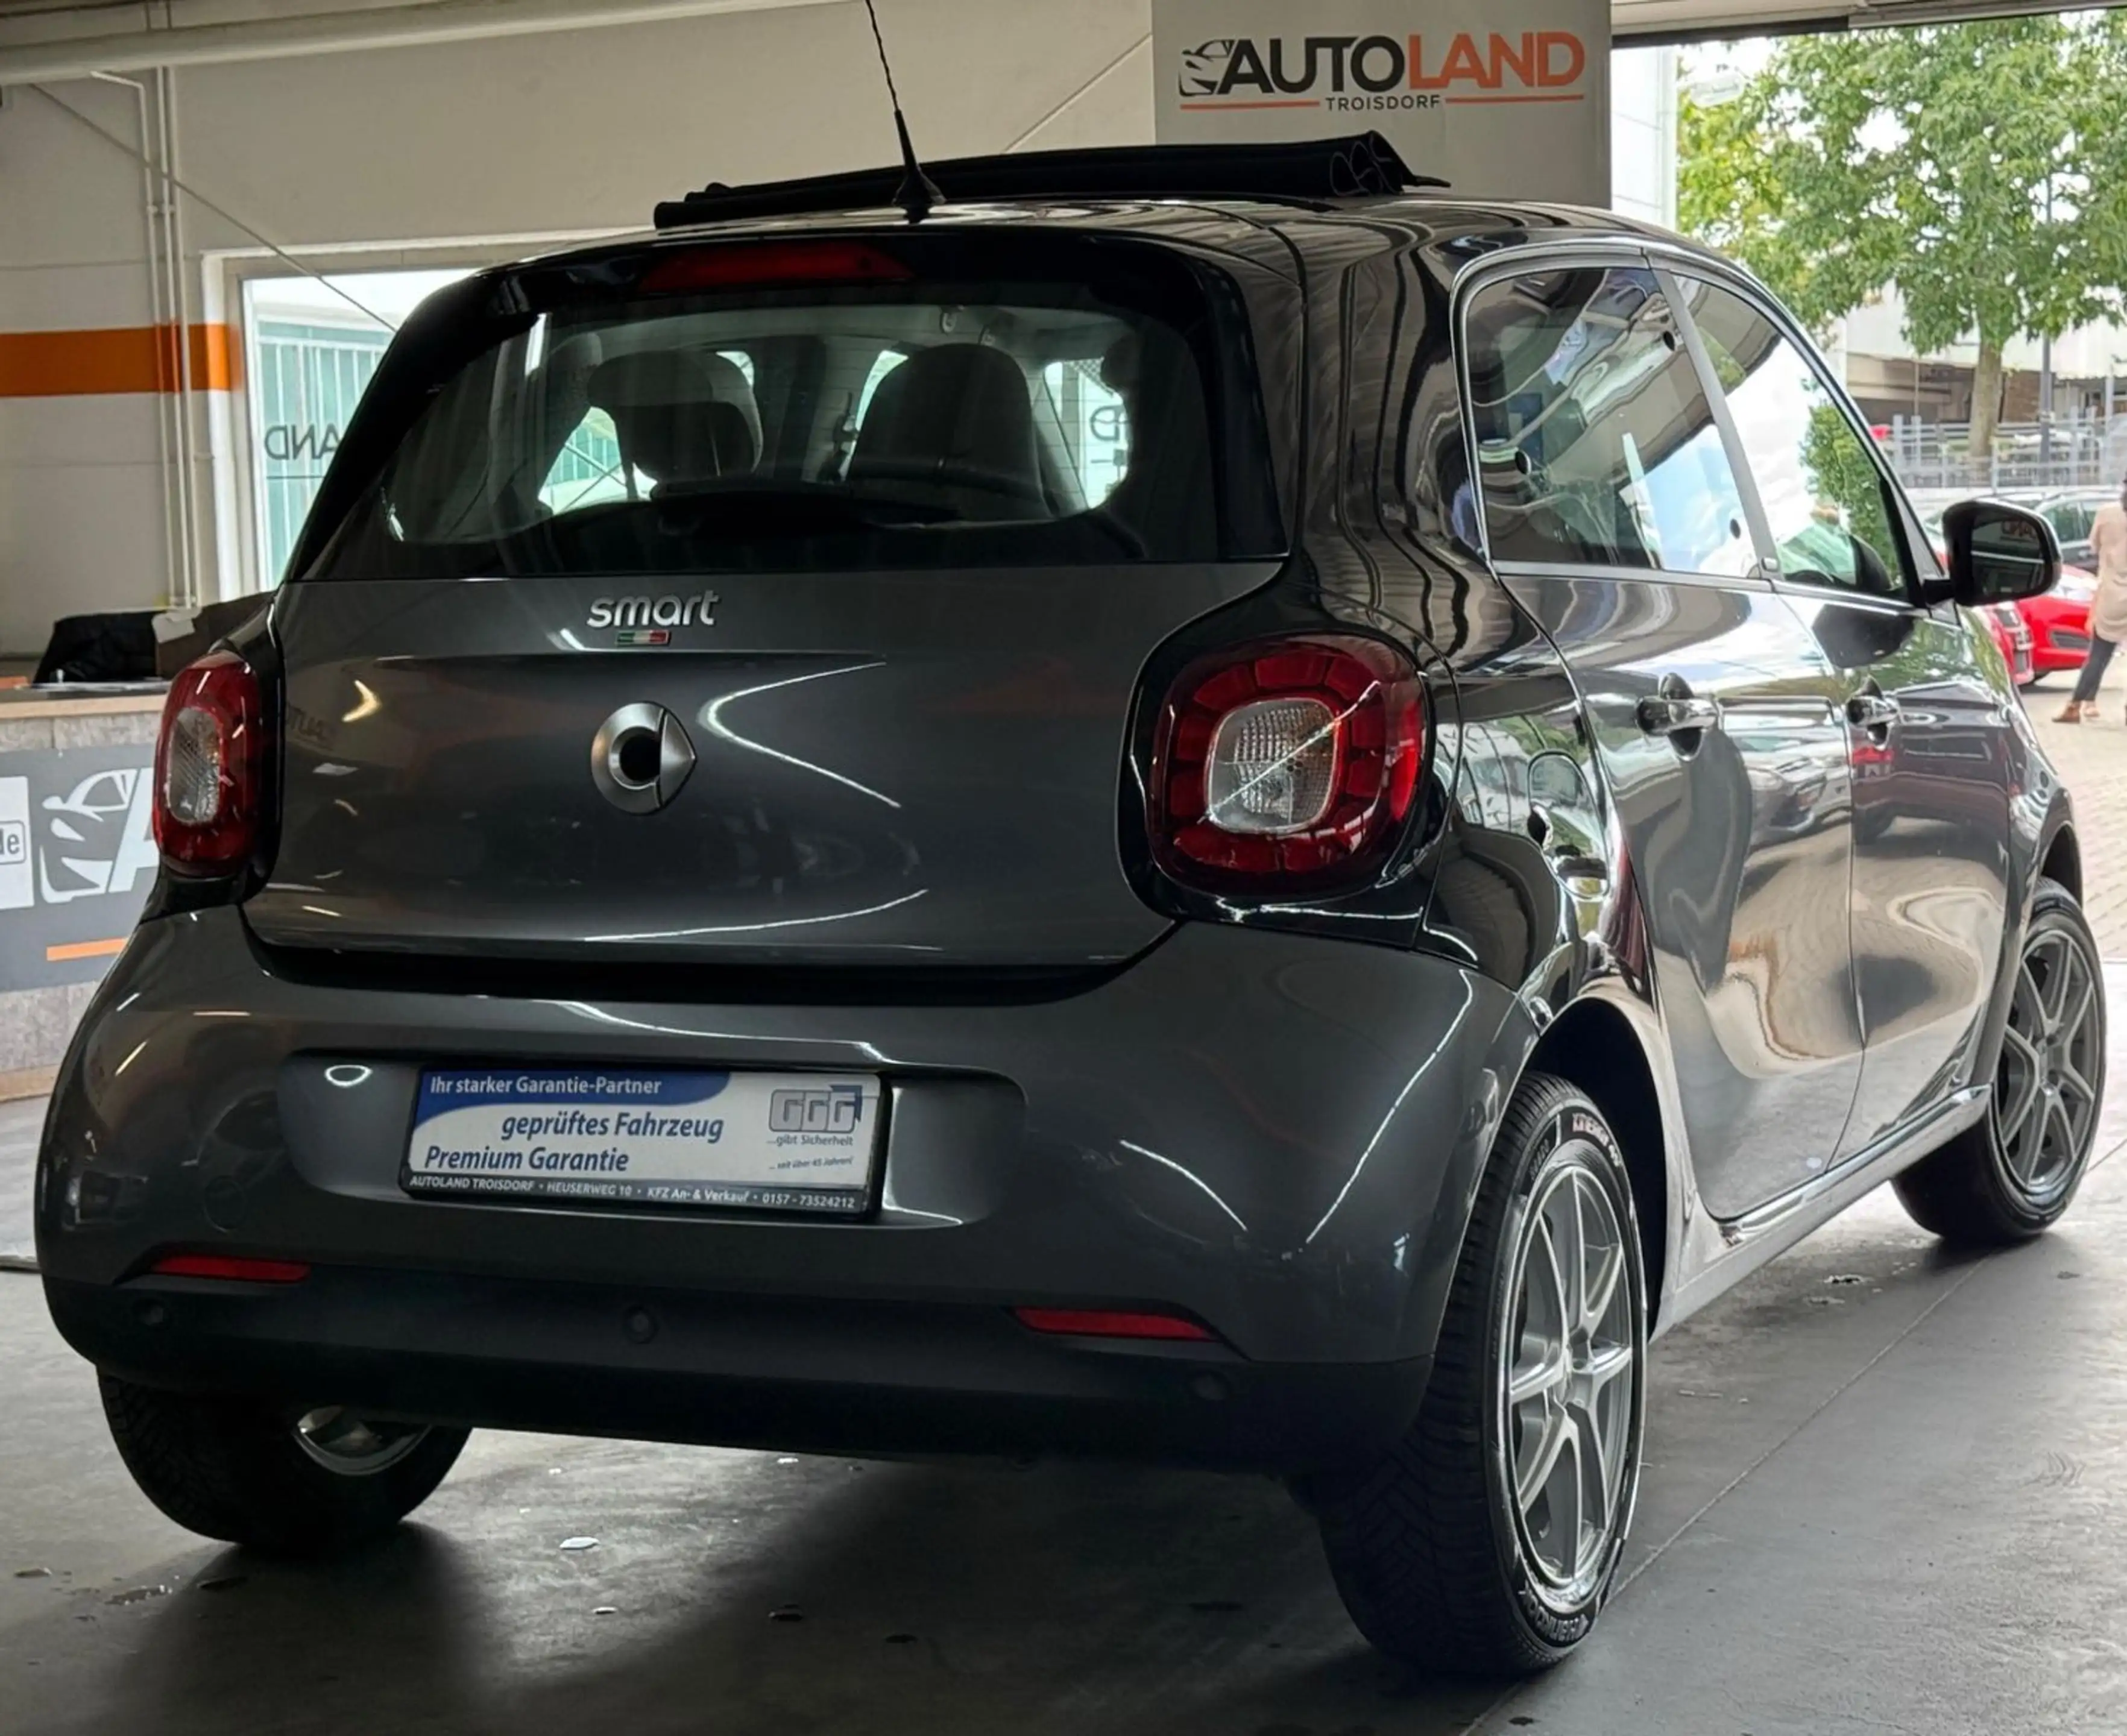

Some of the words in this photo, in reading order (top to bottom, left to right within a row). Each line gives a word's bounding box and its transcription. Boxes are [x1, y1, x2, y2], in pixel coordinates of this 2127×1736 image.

[1217, 32, 1586, 95] AUTOLAND
[1326, 94, 1440, 112] TROISDORF
[587, 590, 719, 627] smart
[430, 1076, 453, 1093] Ihr
[456, 1076, 512, 1093] starker
[516, 1076, 662, 1094] Garantie-Partner
[501, 1110, 610, 1141] geprüftes
[614, 1111, 723, 1143] Fahrzeug
[801, 1134, 853, 1146] Sicherheit
[424, 1145, 523, 1169] Premium
[528, 1146, 629, 1171] Garantie
[409, 1175, 470, 1189] AUTOLAND
[473, 1178, 535, 1191] TROISDORF
[546, 1181, 616, 1196] HEUSERWEG
[620, 1183, 632, 1197] 10
[648, 1186, 670, 1199] KFZ
[671, 1188, 691, 1200] An-
[692, 1188, 701, 1200] &
[704, 1189, 750, 1203] Verkauf
[762, 1192, 790, 1204] 0157
